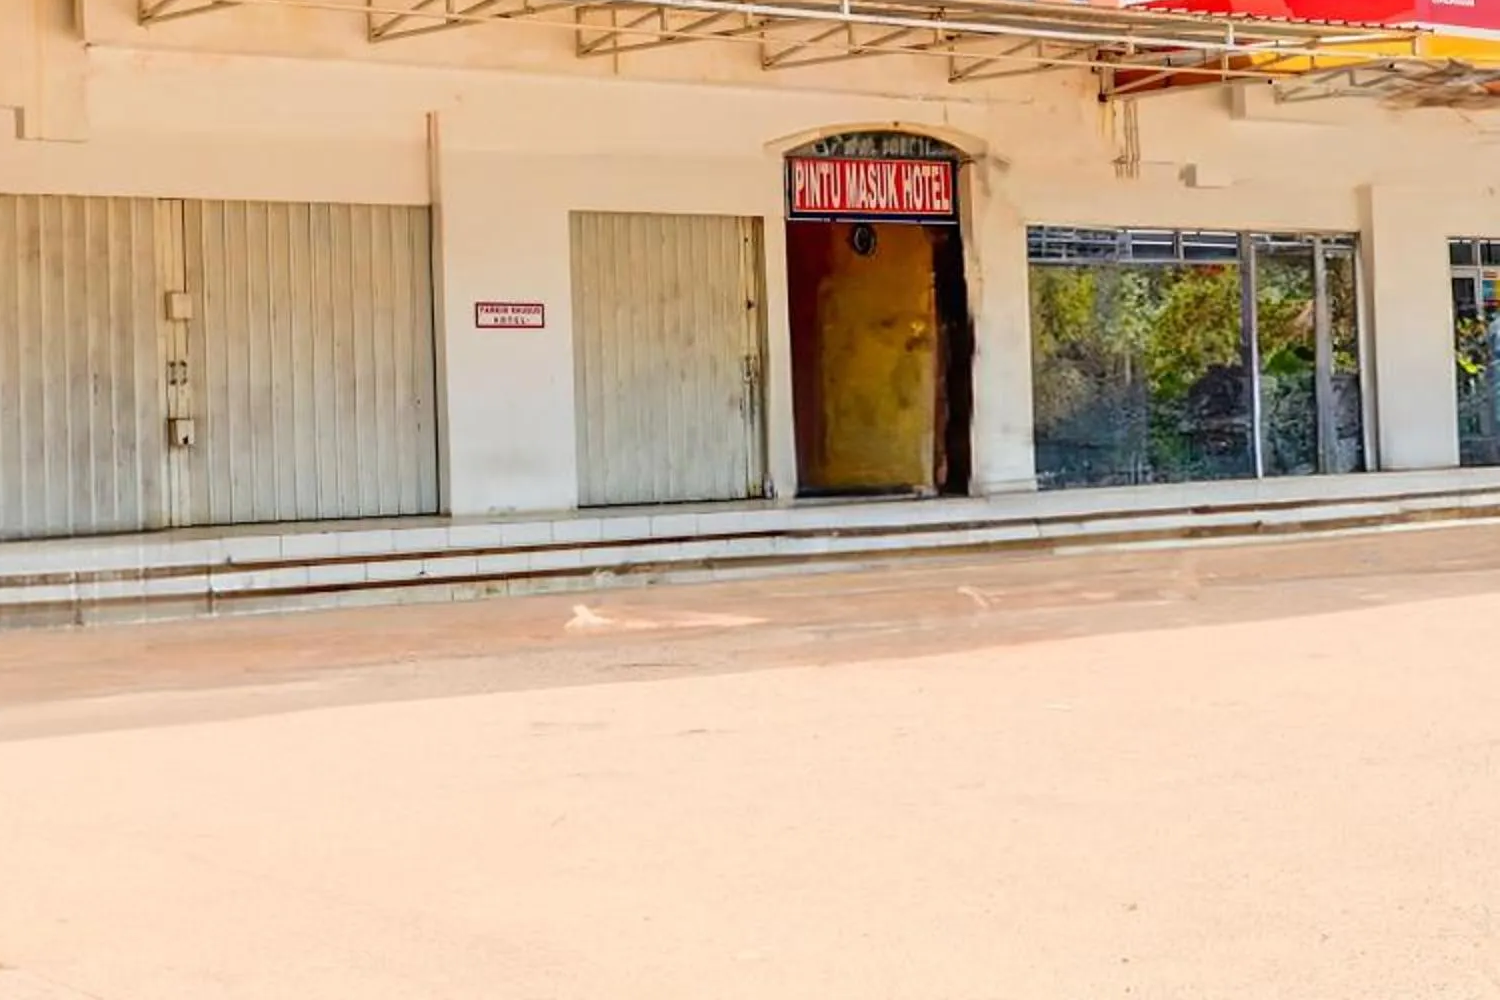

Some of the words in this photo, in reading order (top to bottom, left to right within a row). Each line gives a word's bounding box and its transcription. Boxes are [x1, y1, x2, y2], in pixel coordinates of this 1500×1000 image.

[795, 162, 840, 208] PINTU
[845, 163, 898, 209] MASUK
[902, 165, 949, 210] HOTEL
